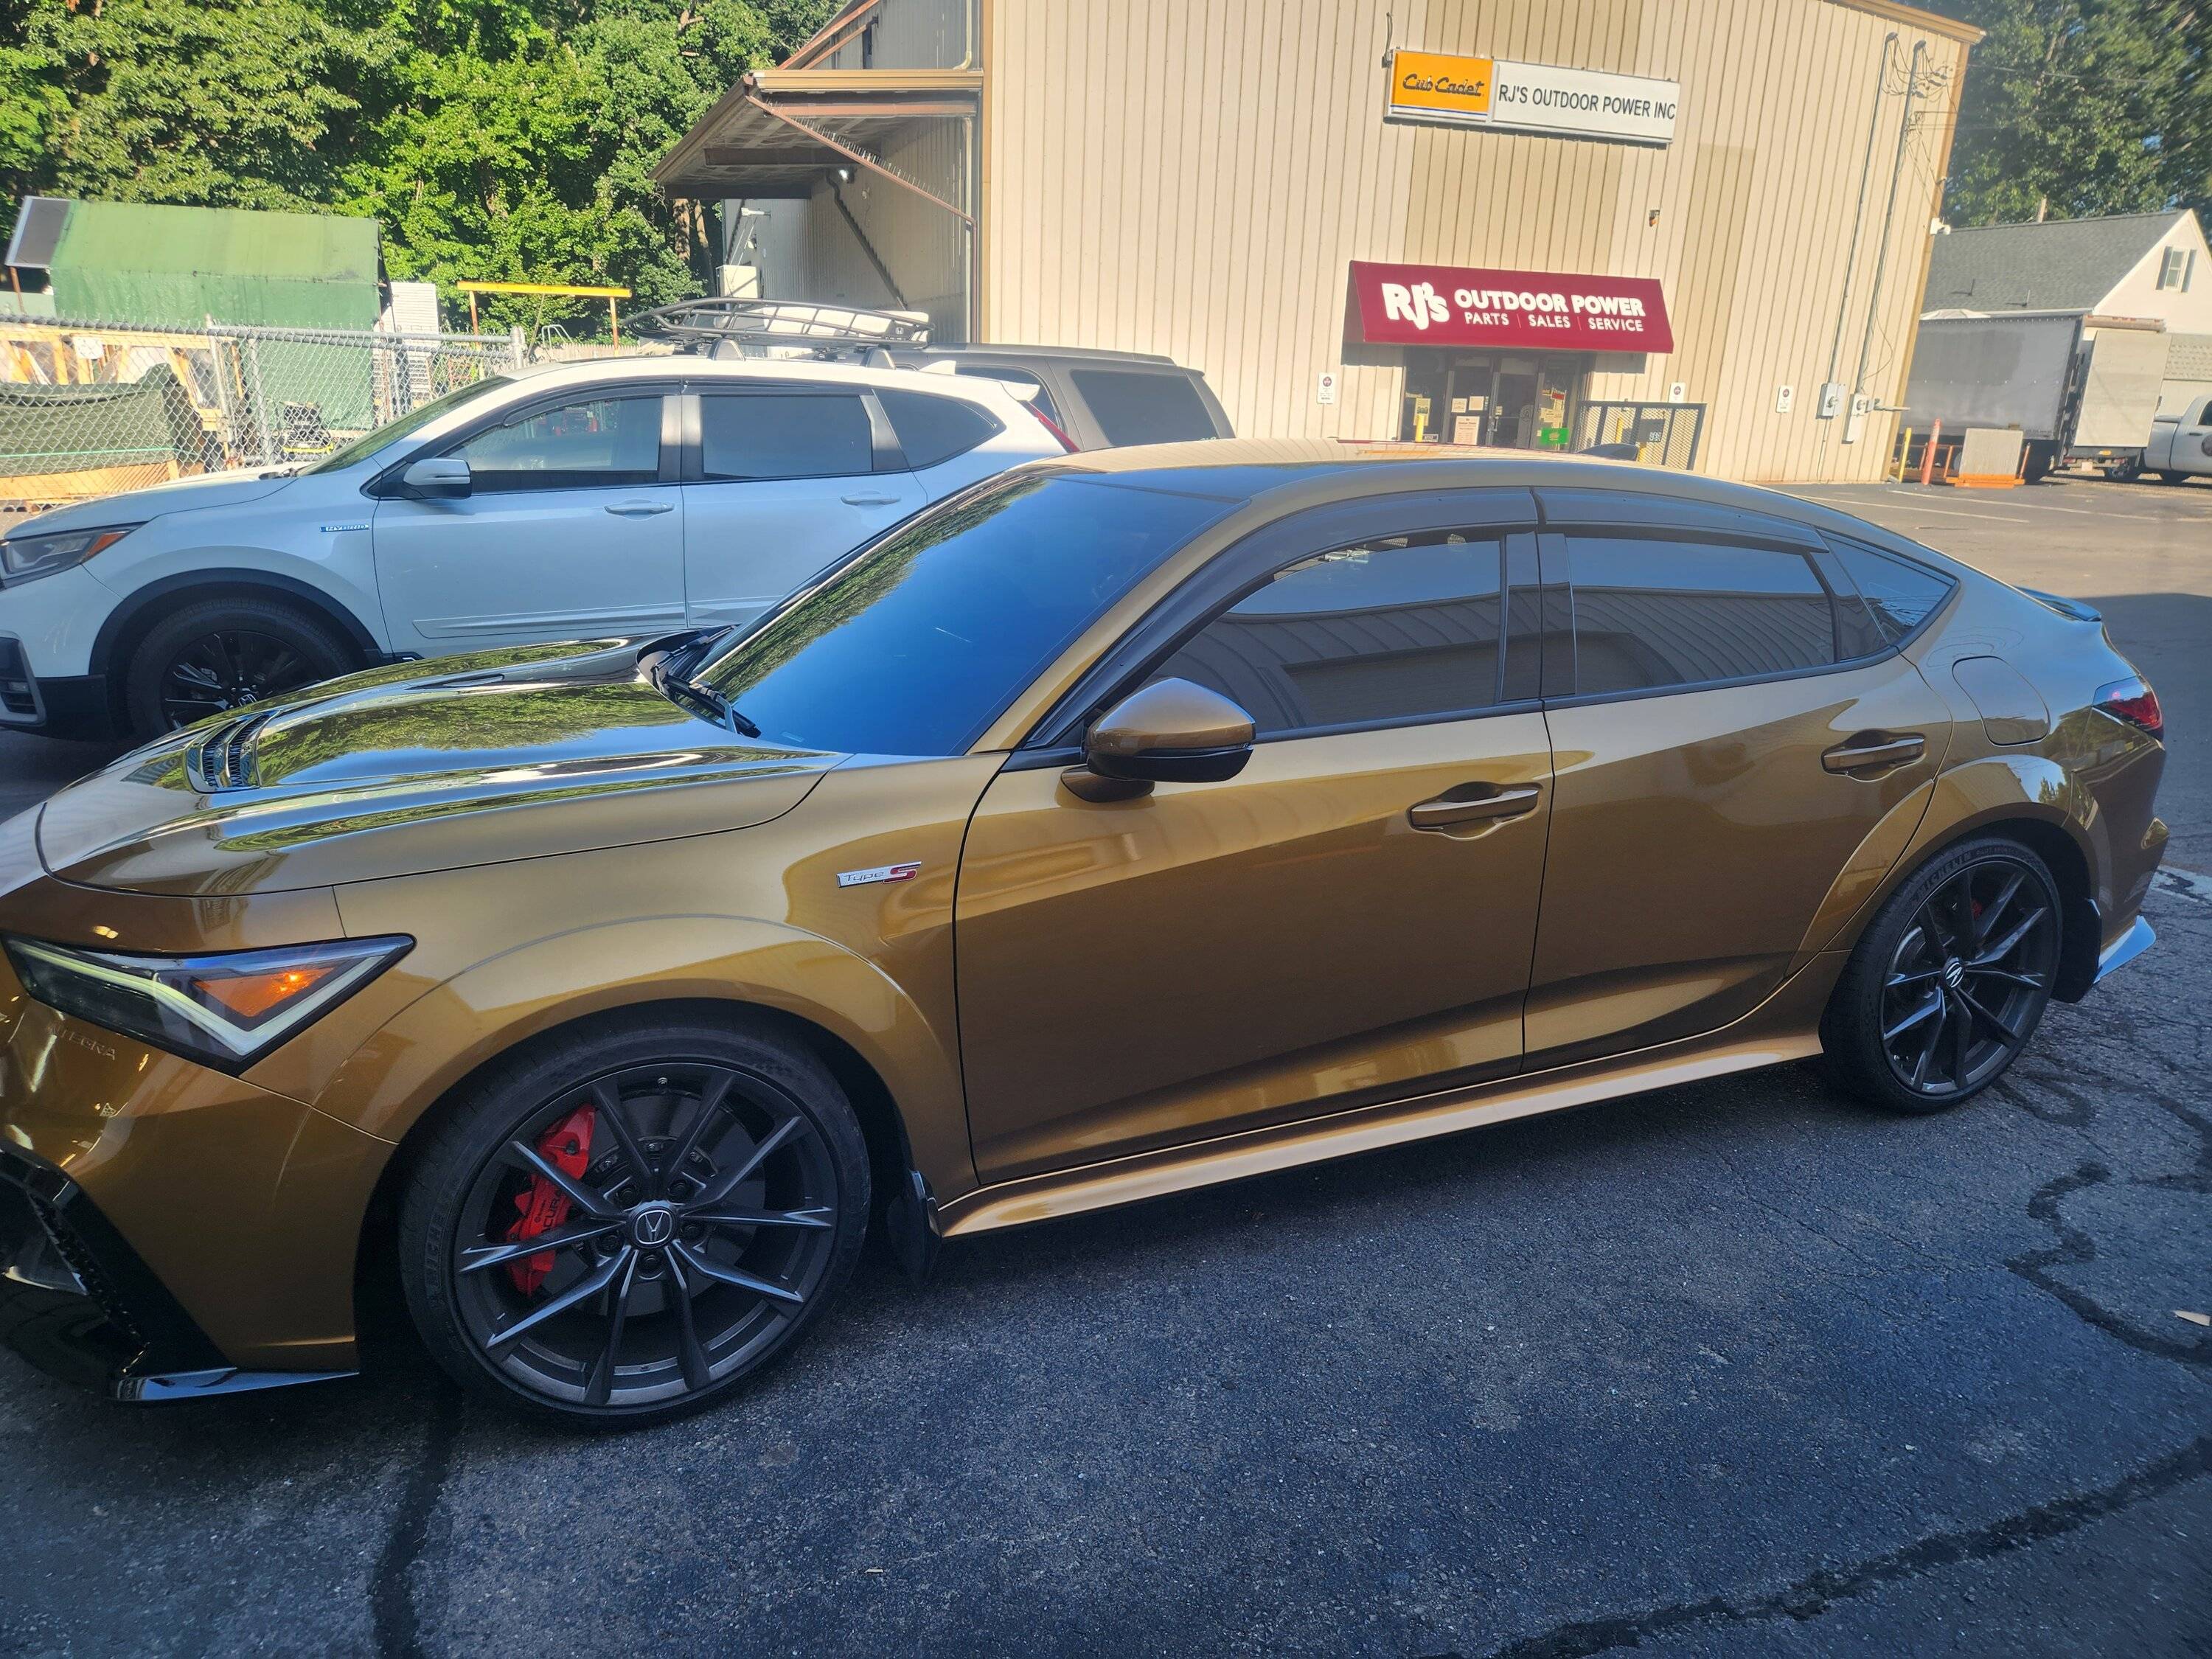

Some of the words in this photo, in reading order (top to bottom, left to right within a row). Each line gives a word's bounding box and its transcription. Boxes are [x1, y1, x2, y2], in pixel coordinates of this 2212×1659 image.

[1402, 73, 1433, 91] Cub
[1435, 77, 1484, 97] Cadet
[1498, 84, 1528, 103] RJ'S
[1532, 88, 1598, 112] OUTDOOR
[1602, 96, 1650, 117] POWER
[1654, 102, 1676, 119] INC
[1454, 288, 1569, 313] OUTDOOR
[1571, 294, 1646, 316] POWER
[1464, 311, 1509, 326] PARTS
[1528, 314, 1571, 328] SALES
[1587, 317, 1644, 332] SERVICE
[844, 872, 884, 883] Type
[883, 863, 920, 884] S
